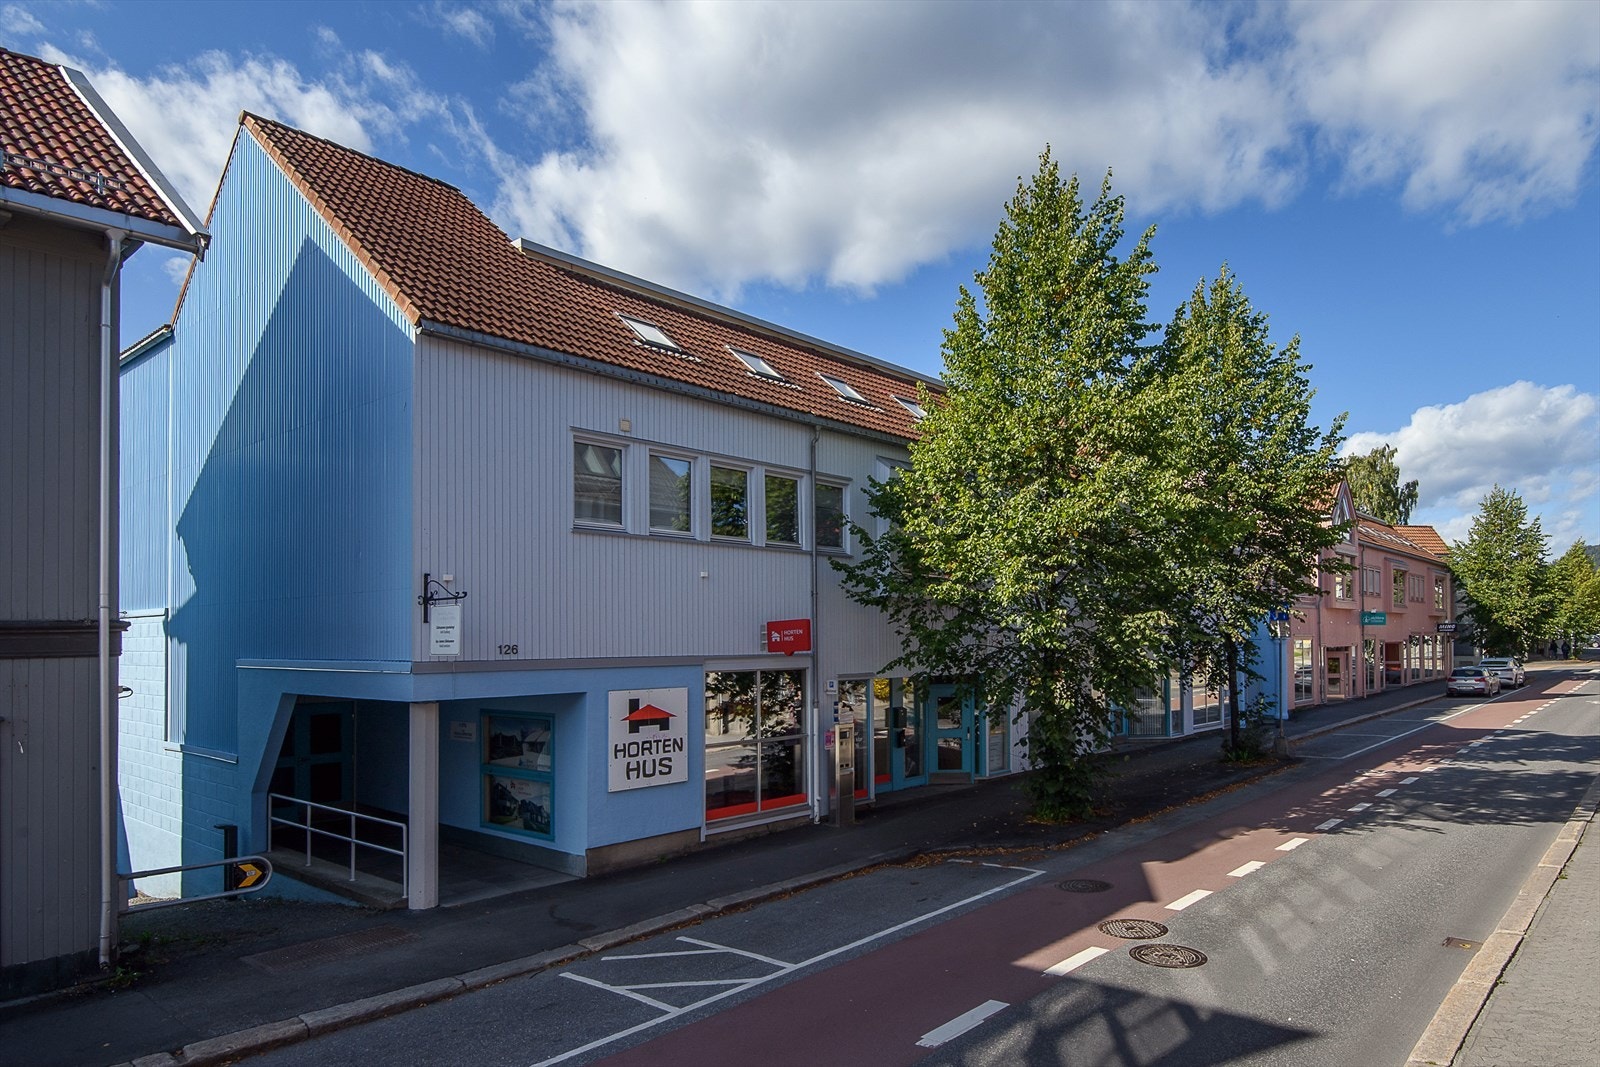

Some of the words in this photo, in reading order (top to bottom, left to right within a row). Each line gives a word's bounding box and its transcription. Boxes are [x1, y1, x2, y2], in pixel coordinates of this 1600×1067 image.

[498, 644, 519, 655] 126
[614, 737, 684, 759] HORTEN
[626, 757, 673, 780] HUS
